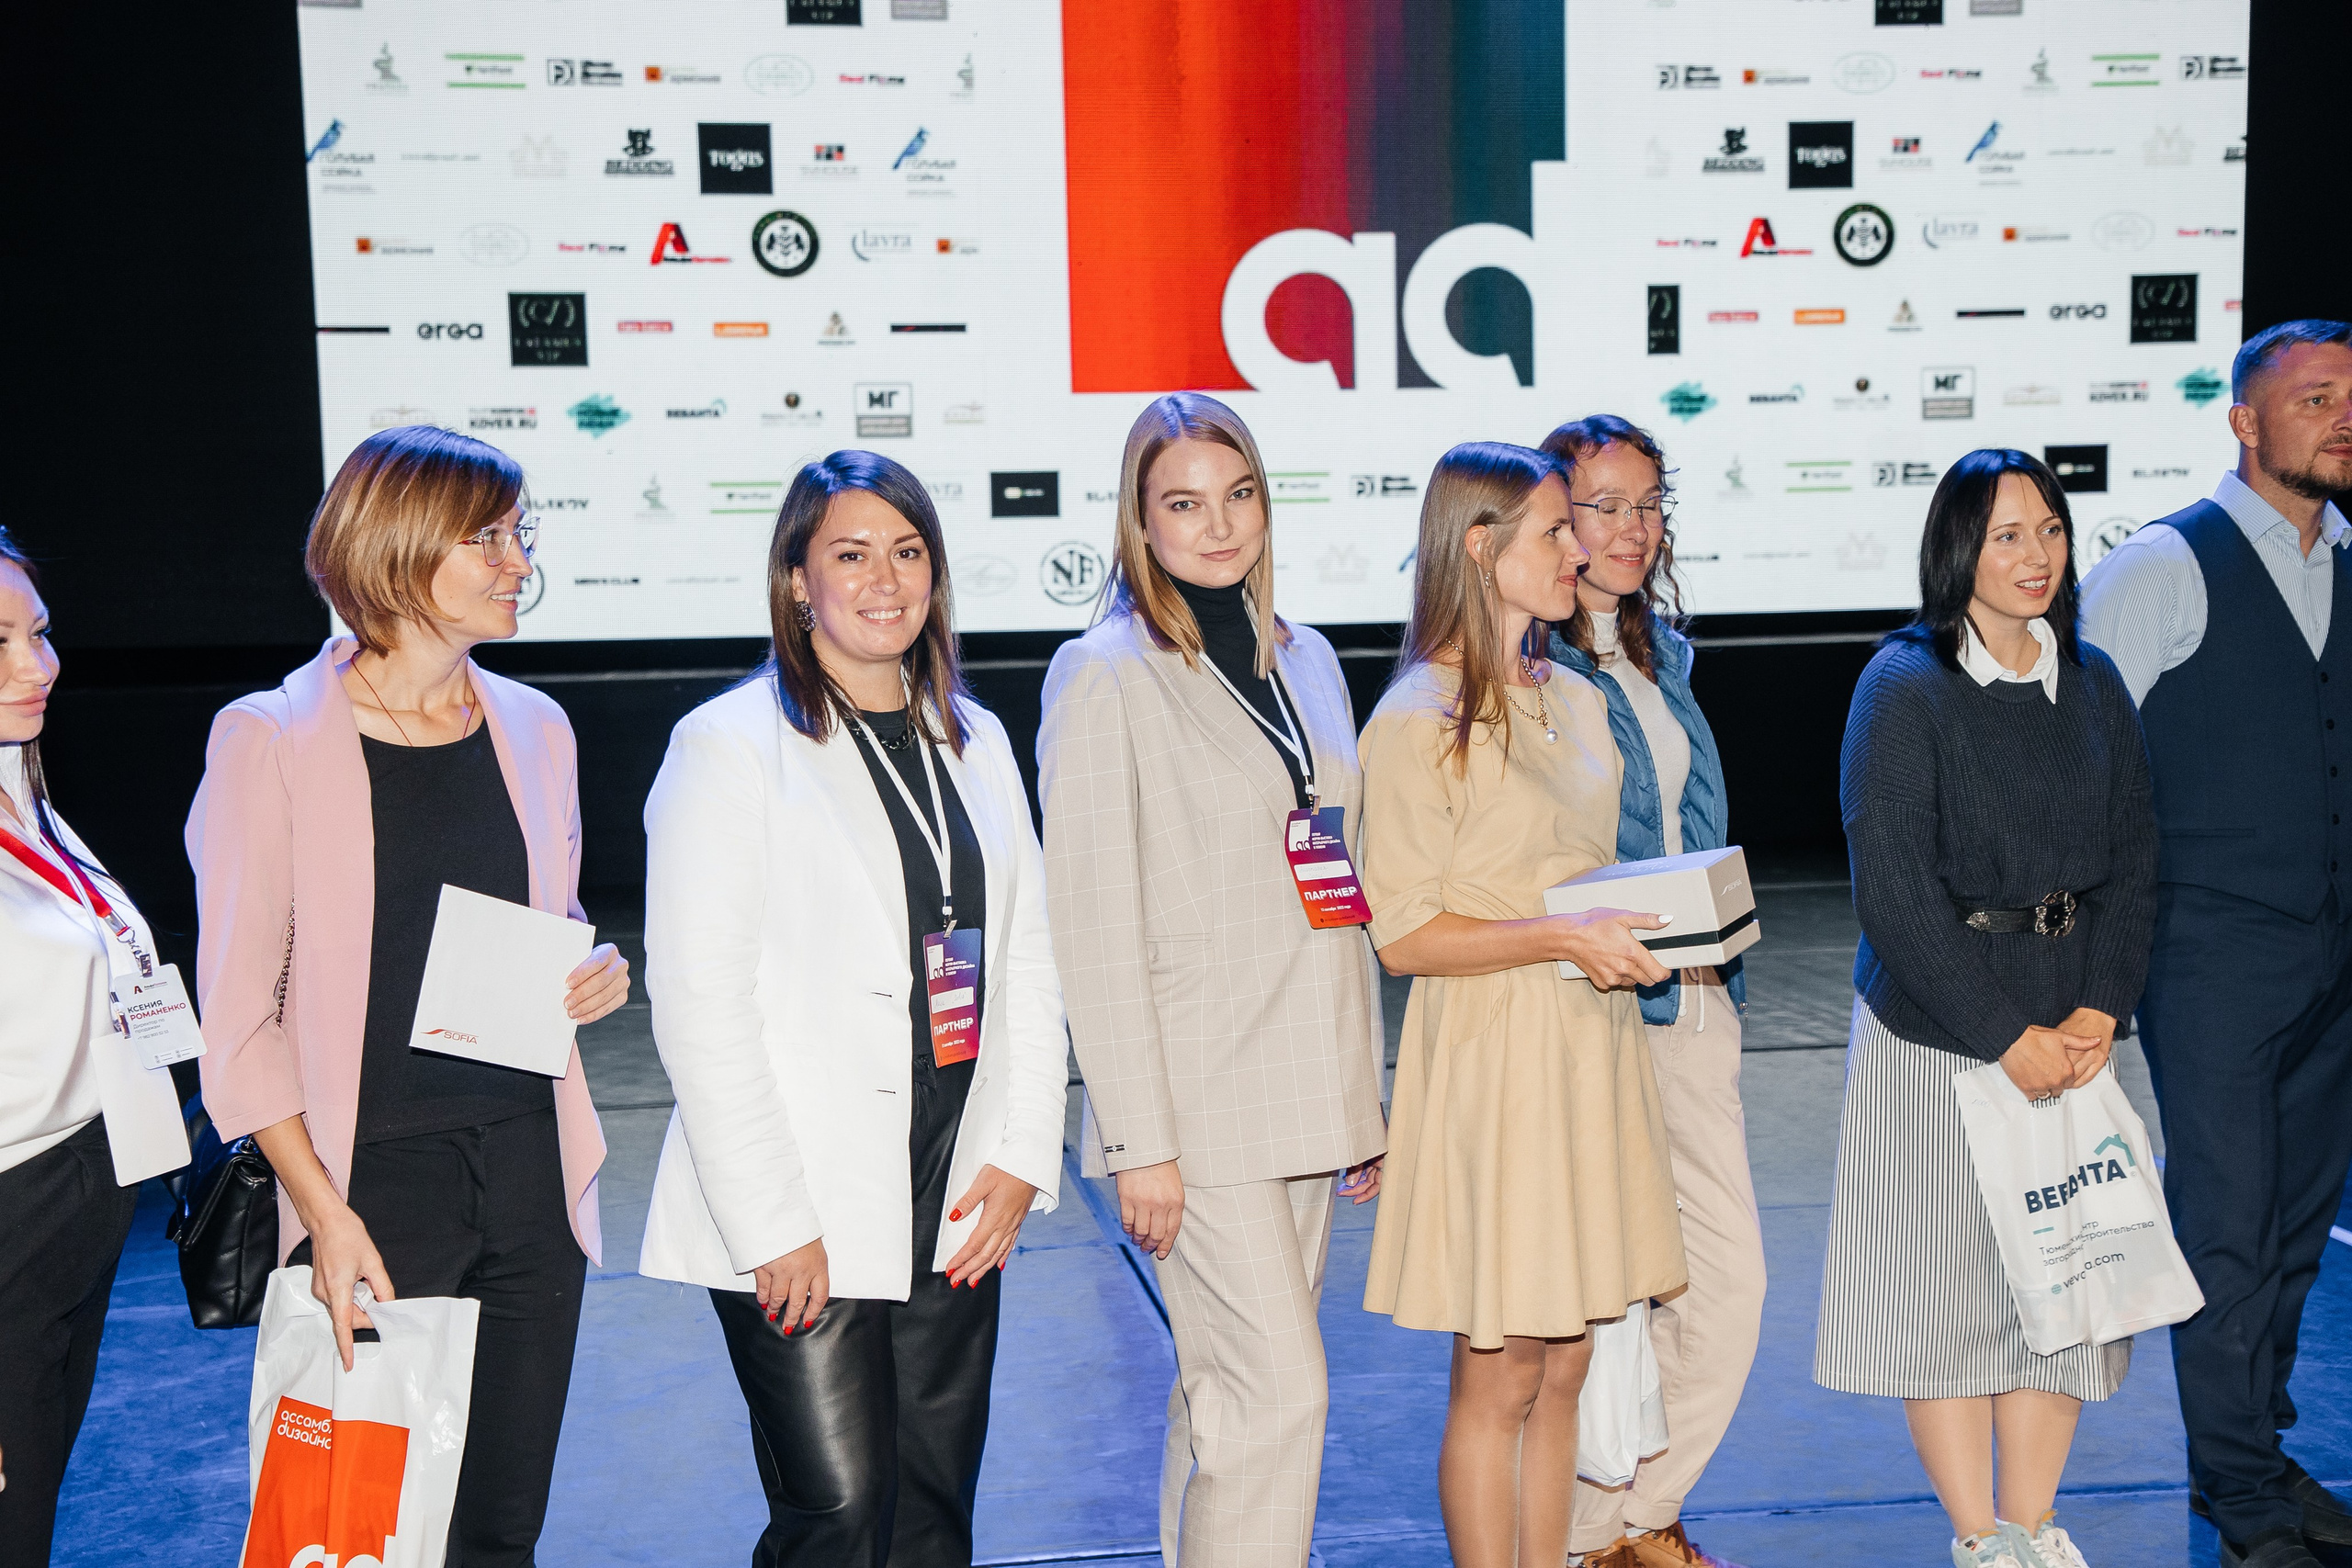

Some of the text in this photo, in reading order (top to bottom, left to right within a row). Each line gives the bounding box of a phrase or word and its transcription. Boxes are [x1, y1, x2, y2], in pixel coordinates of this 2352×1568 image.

[1304, 886, 1358, 901] ПАРТНЕР
[127, 999, 164, 1013] КСЕНИЯ
[130, 1002, 187, 1021] РОМАНЕНКО
[933, 1017, 974, 1036] ПАРТНЕР
[444, 1031, 479, 1045] SOFIA
